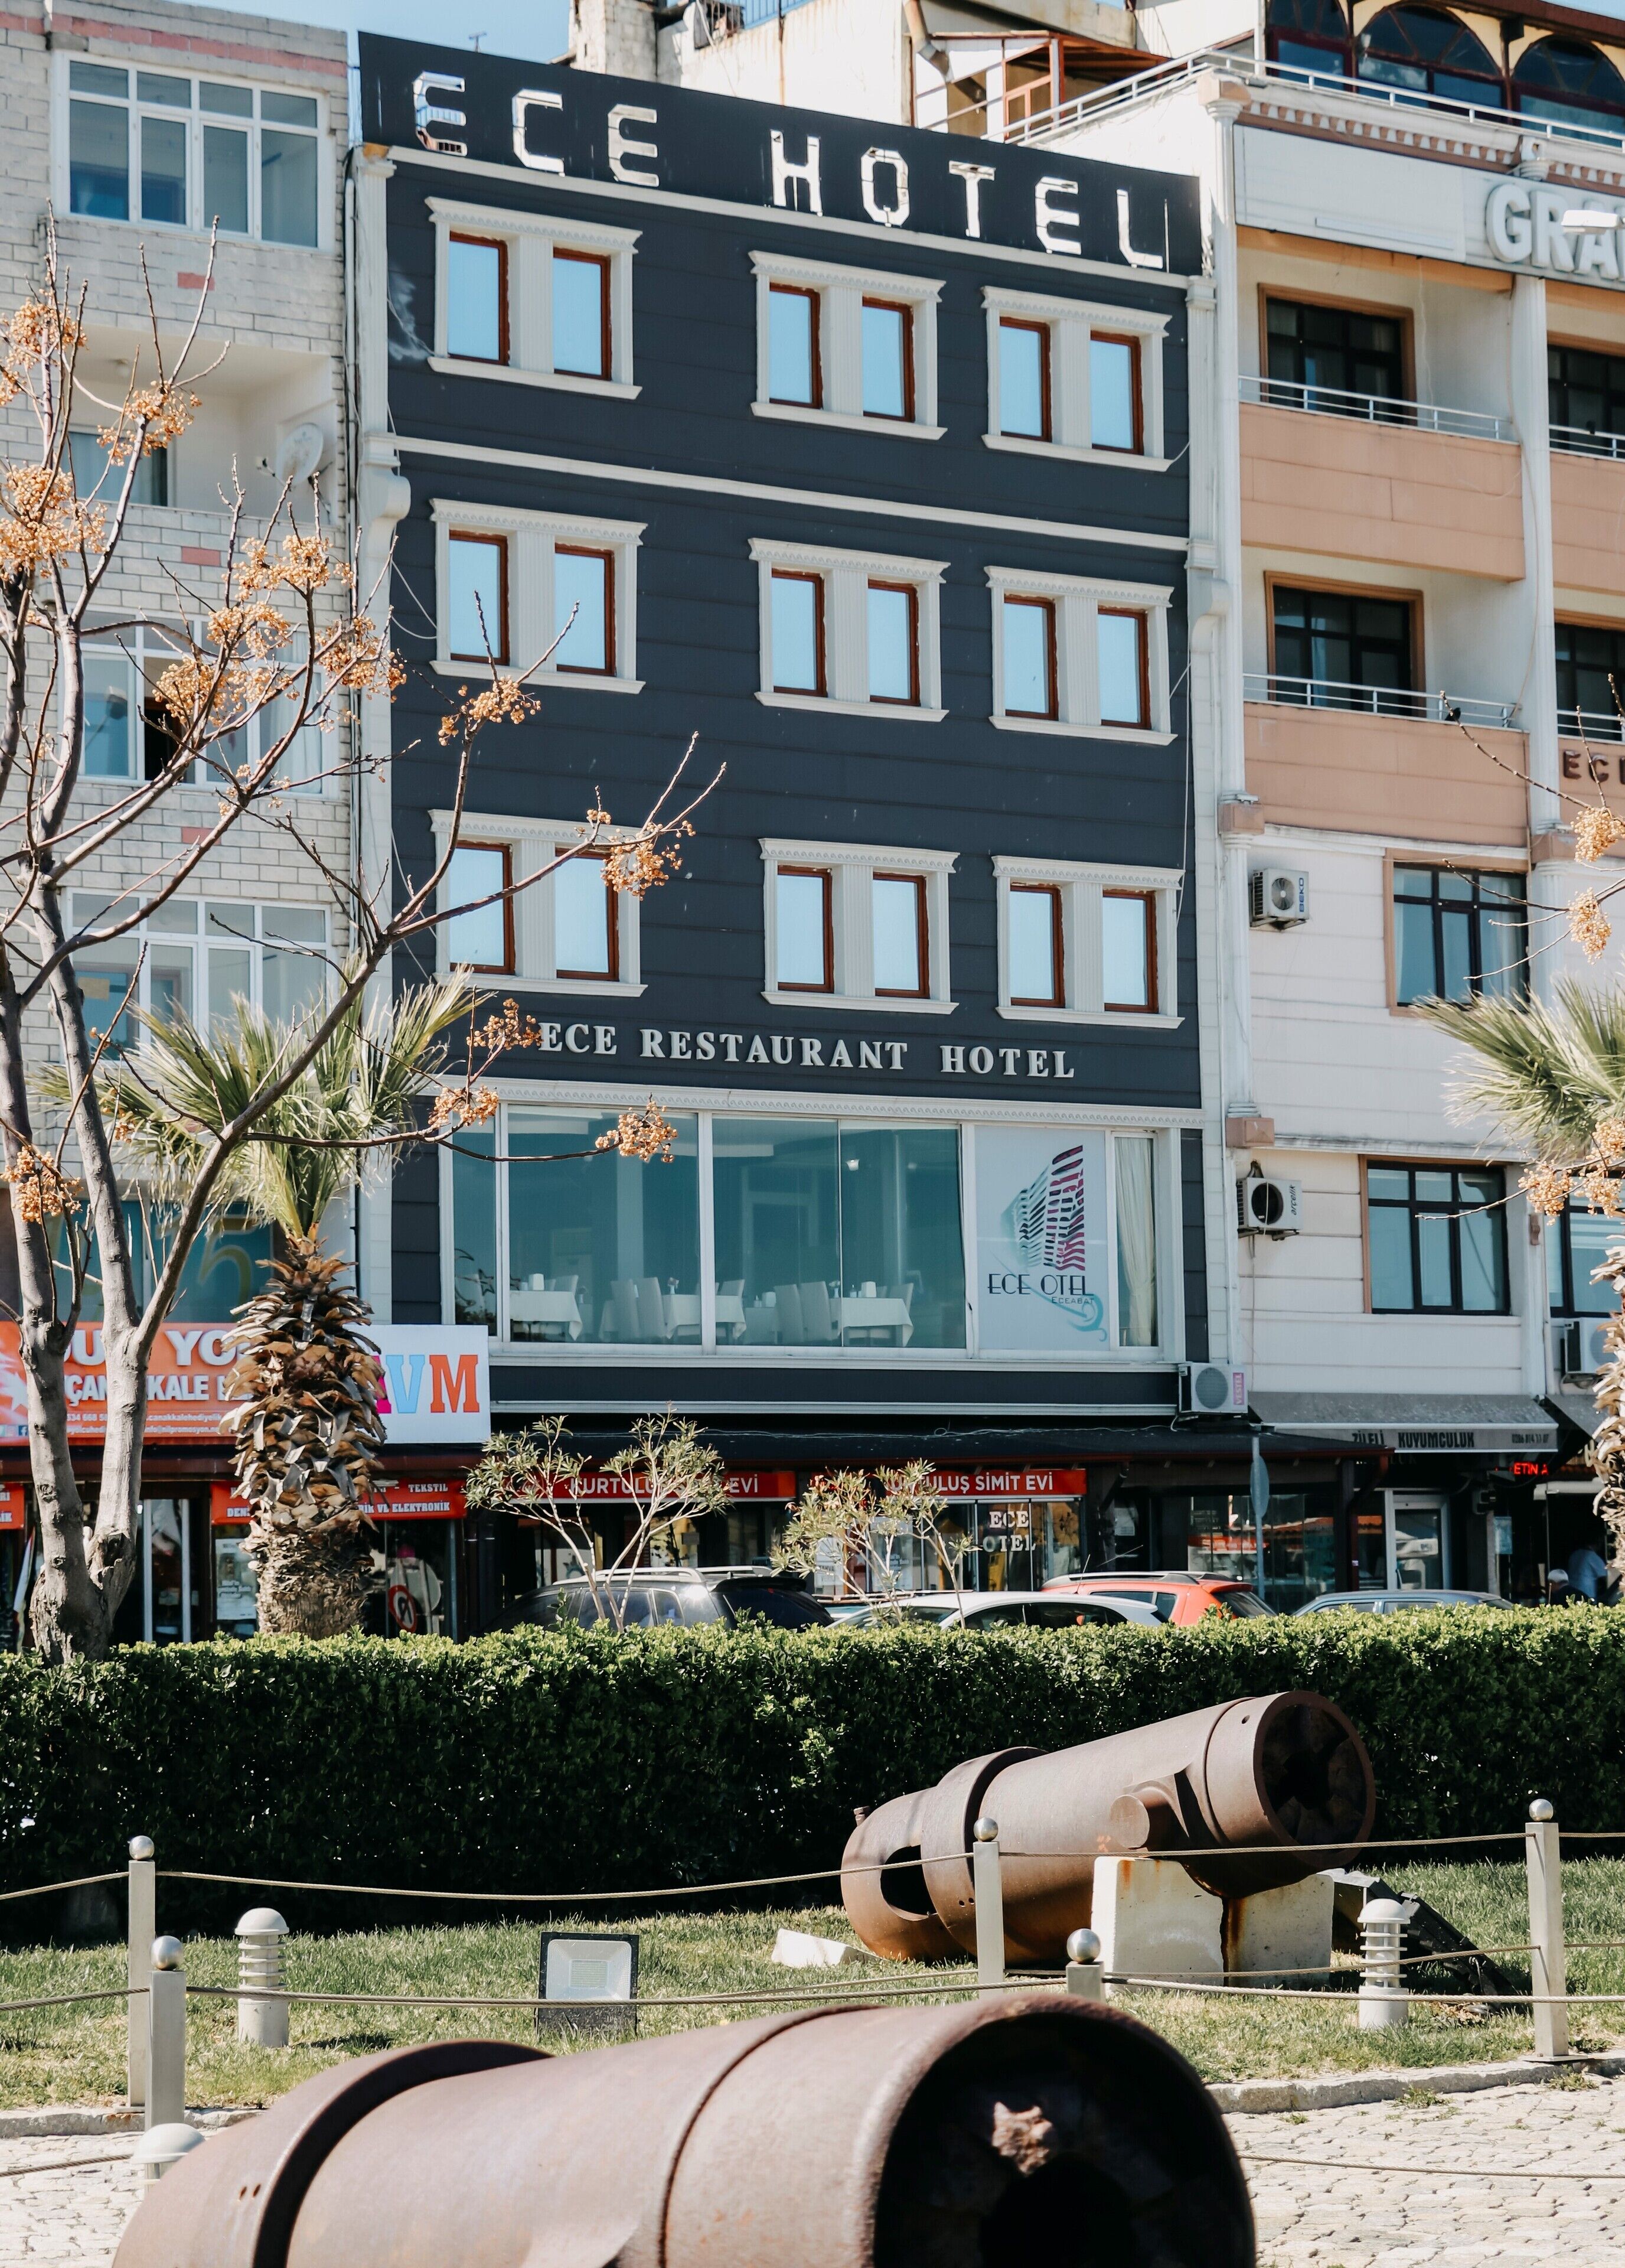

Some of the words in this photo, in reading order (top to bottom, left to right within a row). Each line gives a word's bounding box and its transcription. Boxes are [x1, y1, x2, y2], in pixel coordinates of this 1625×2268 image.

[413, 71, 659, 187] ECE
[770, 129, 1164, 269] HOTEL
[1485, 183, 1625, 282] GRA
[538, 1022, 616, 1055] ECE
[639, 1028, 908, 1070] RESTAURANT
[940, 1045, 1074, 1078] HOTEL
[988, 1273, 1031, 1295] ECE
[1040, 1275, 1094, 1296] OTEL
[1398, 1432, 1475, 1448] KUYUMCULUK
[408, 1483, 448, 1493] TEKSTİL
[975, 1472, 1020, 1491] SİMİT
[1026, 1472, 1053, 1490] EVİ
[391, 1500, 450, 1513] ELEKTRONİK
[989, 1511, 1029, 1529] ECE
